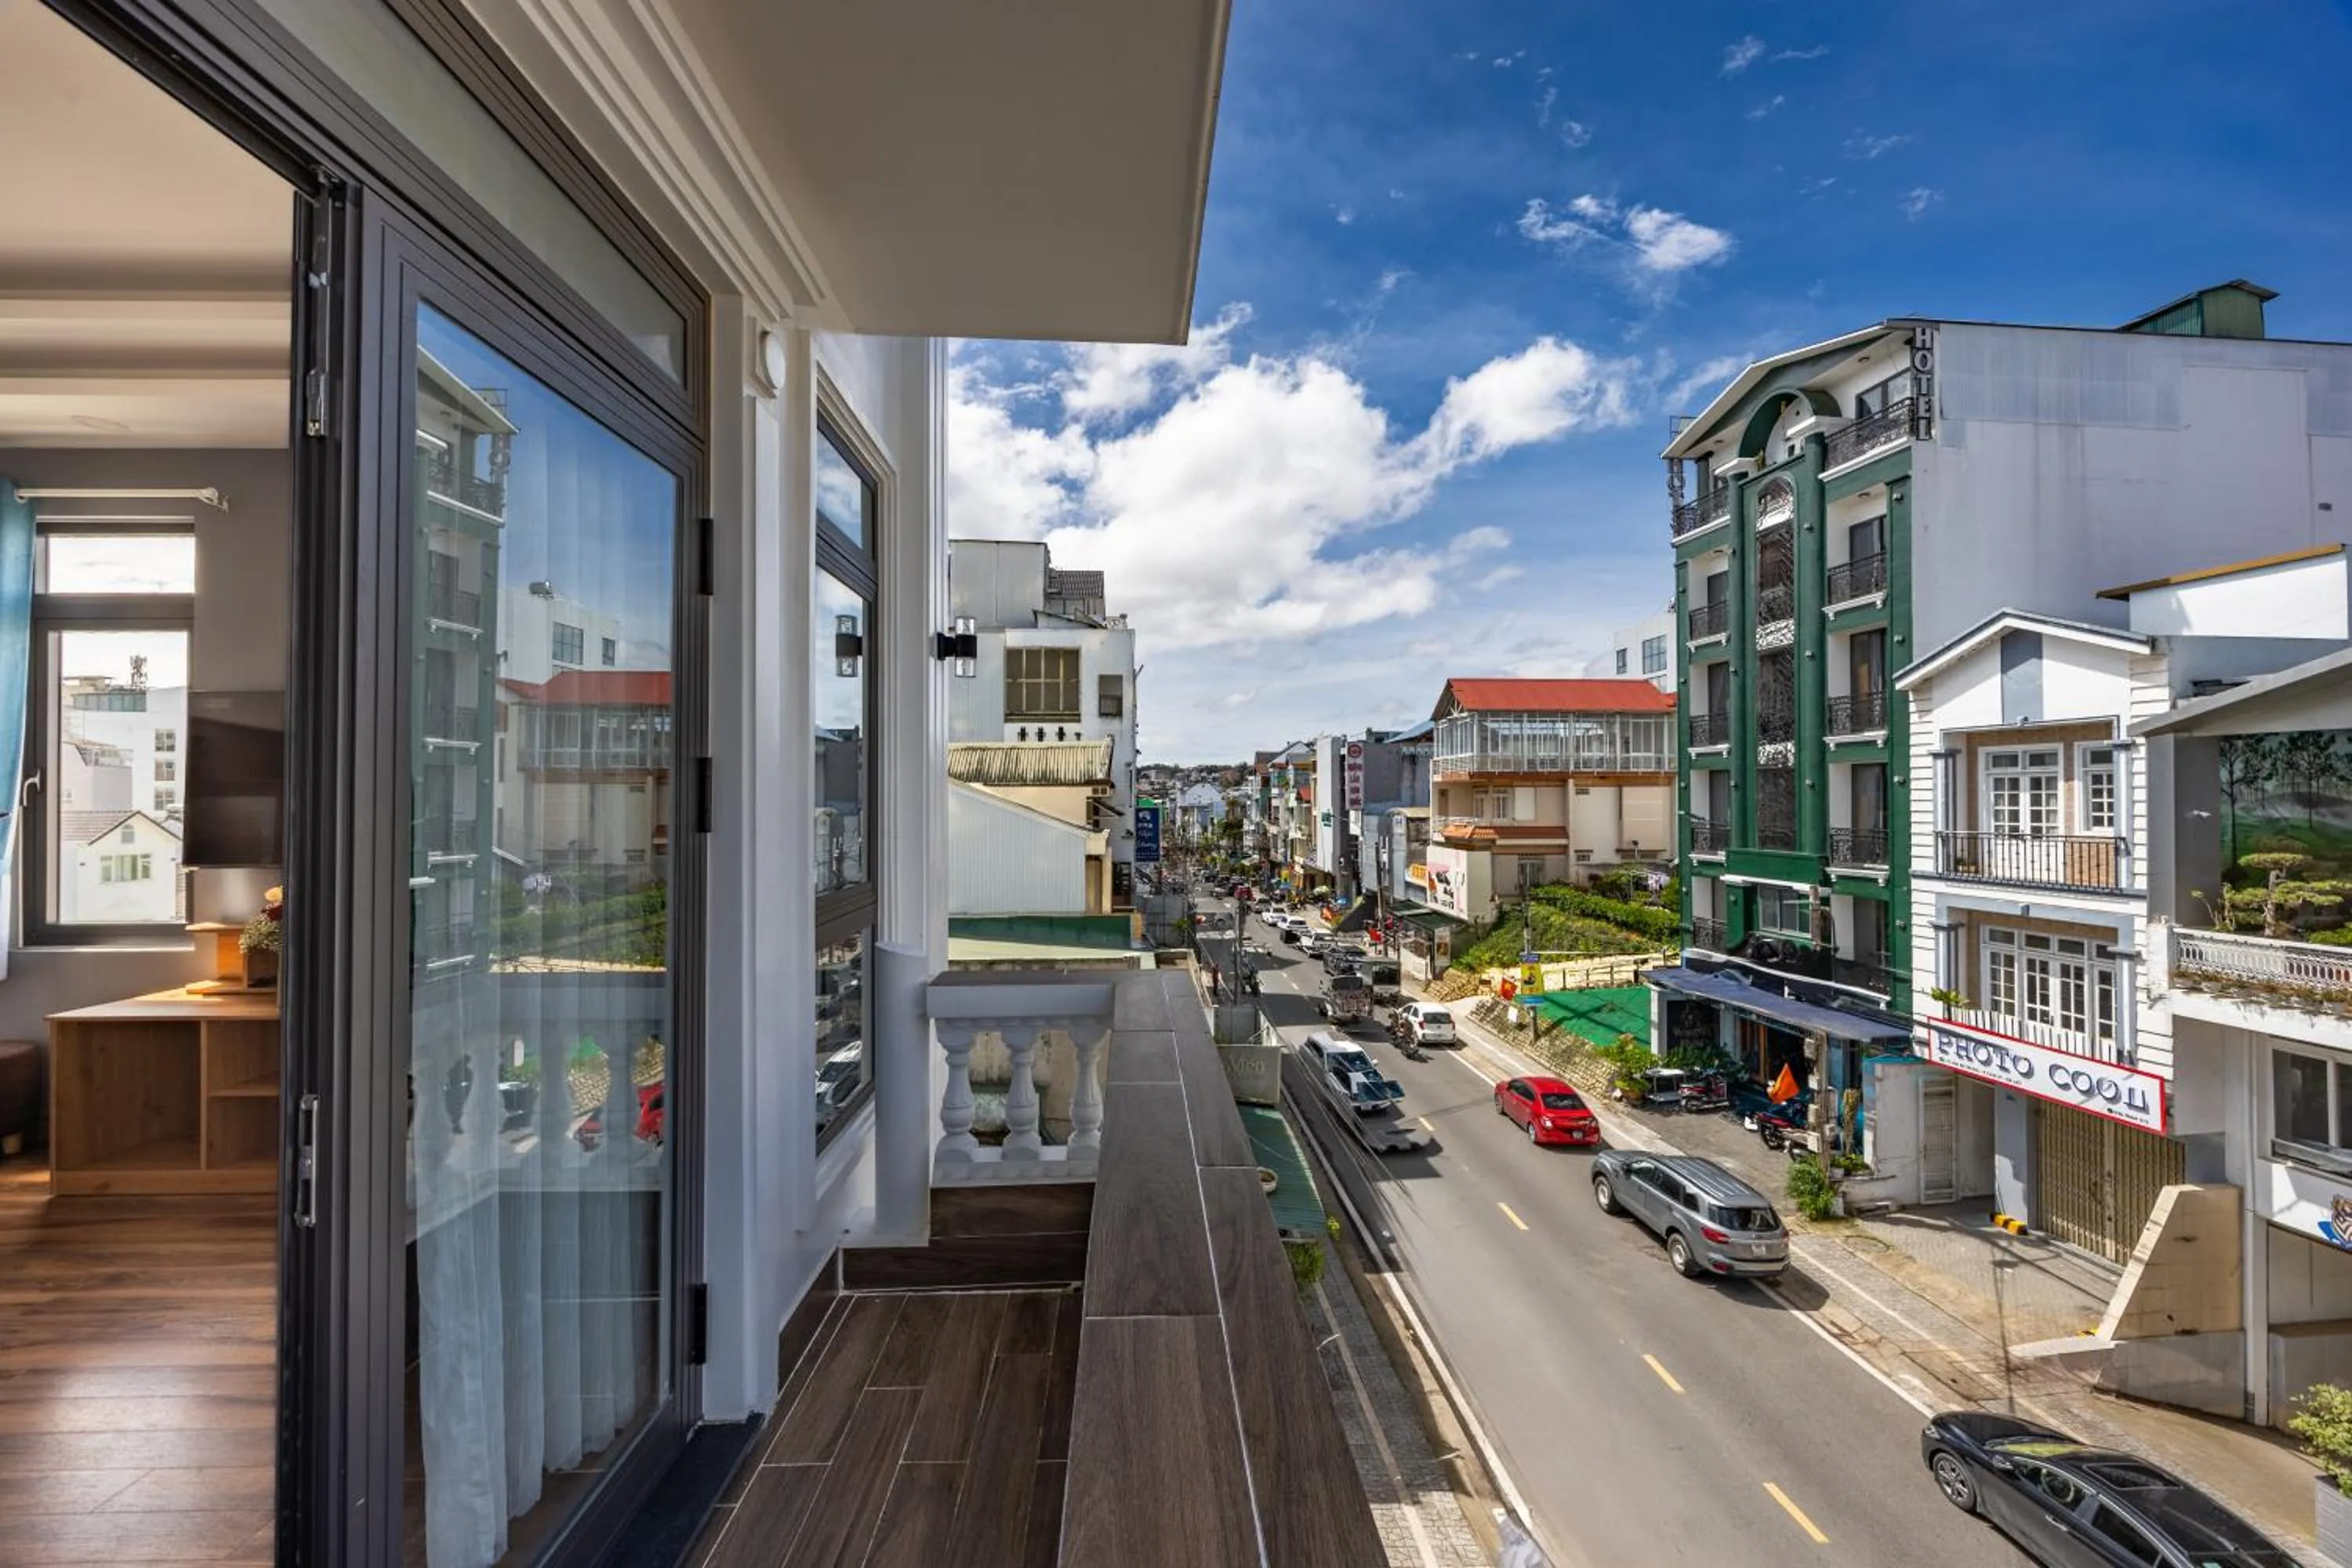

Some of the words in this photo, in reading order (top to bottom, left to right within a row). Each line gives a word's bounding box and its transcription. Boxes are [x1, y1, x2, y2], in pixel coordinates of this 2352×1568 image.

[1913, 326, 1934, 441] HOTEL
[1937, 1030, 2034, 1080] PHOTO
[2049, 1063, 2151, 1115] COOL
